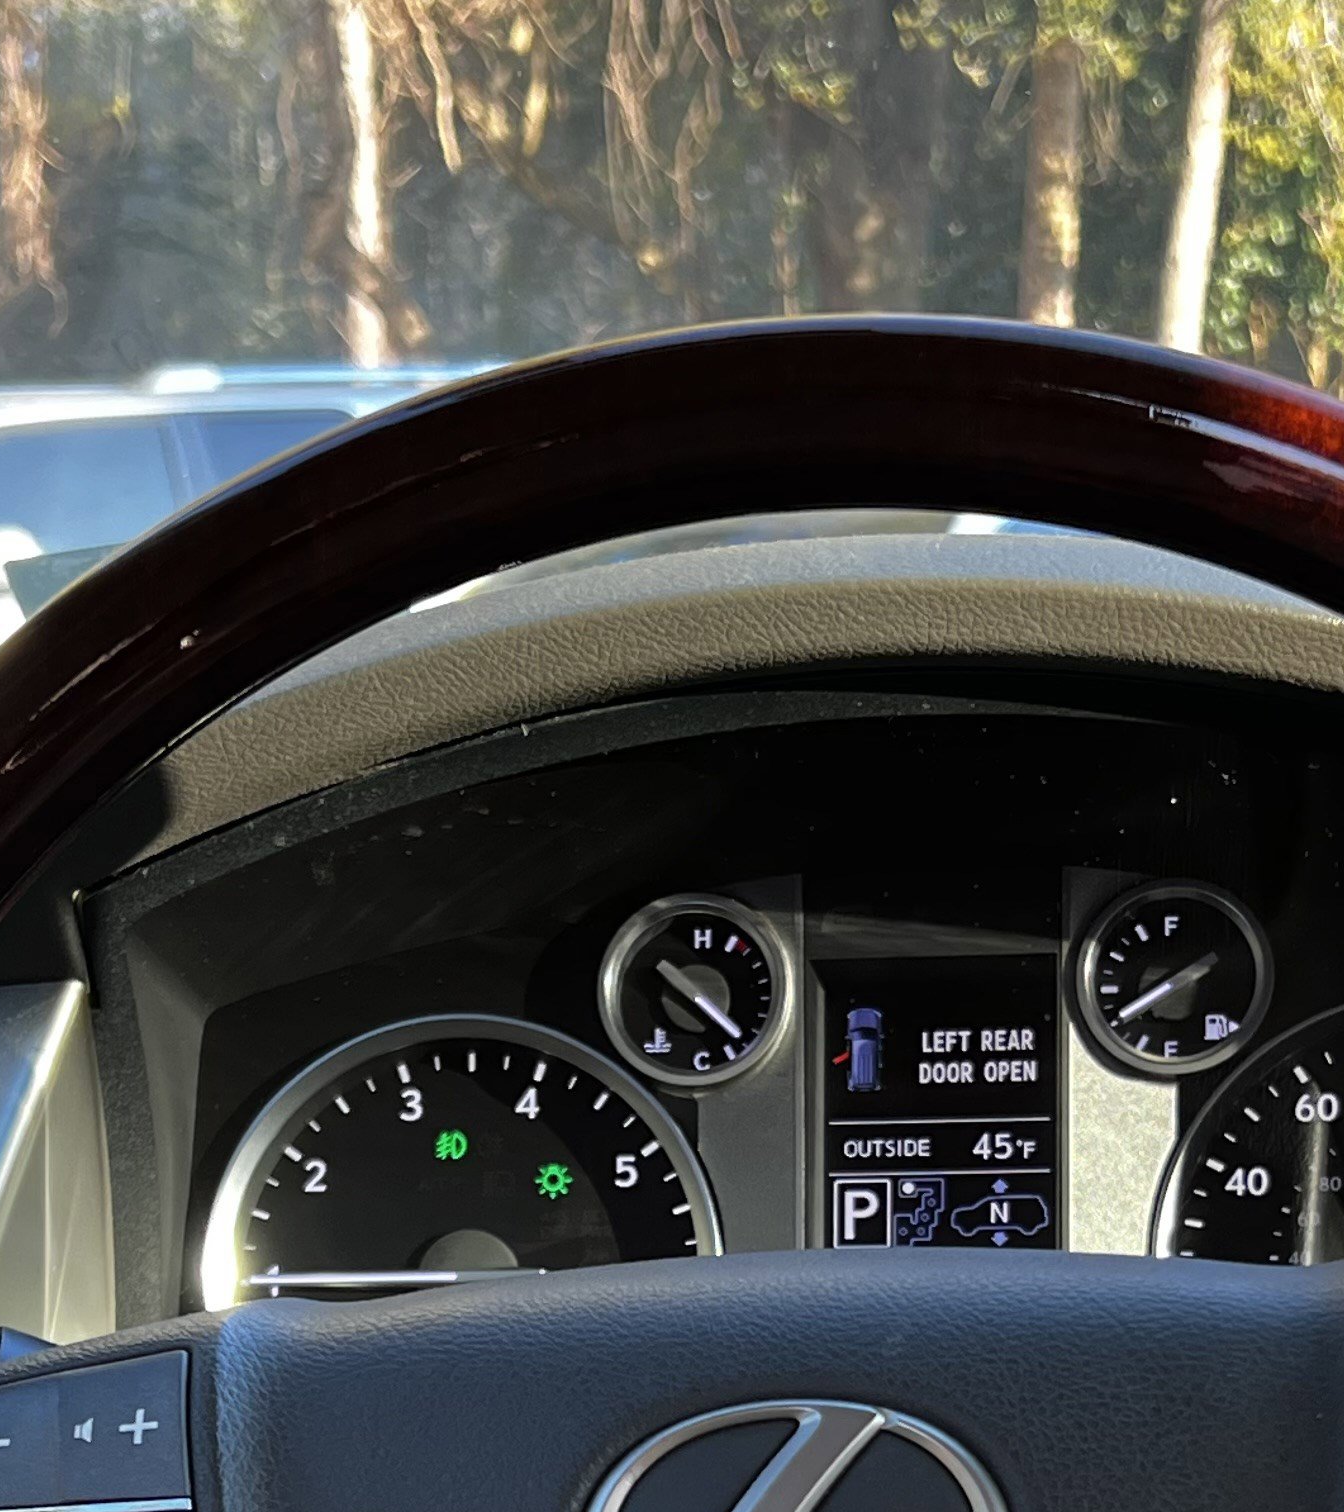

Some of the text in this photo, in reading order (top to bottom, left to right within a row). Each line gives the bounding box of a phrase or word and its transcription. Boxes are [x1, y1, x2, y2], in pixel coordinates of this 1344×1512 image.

[693, 929, 713, 949] H
[1164, 916, 1180, 937] F
[921, 1028, 1035, 1053] LEFT REAR
[692, 1050, 711, 1071] C
[918, 1060, 1038, 1084] DOOR OPEN
[400, 1089, 424, 1122] 3
[514, 1085, 540, 1120] 4
[1295, 1093, 1339, 1123] 60
[843, 1139, 931, 1158] OUTSIDE
[302, 1158, 327, 1192] 2
[615, 1155, 639, 1188] 5
[1225, 1168, 1269, 1196] 40
[1319, 1176, 1342, 1193] 80
[843, 1189, 881, 1240] P
[990, 1202, 1009, 1224] N
